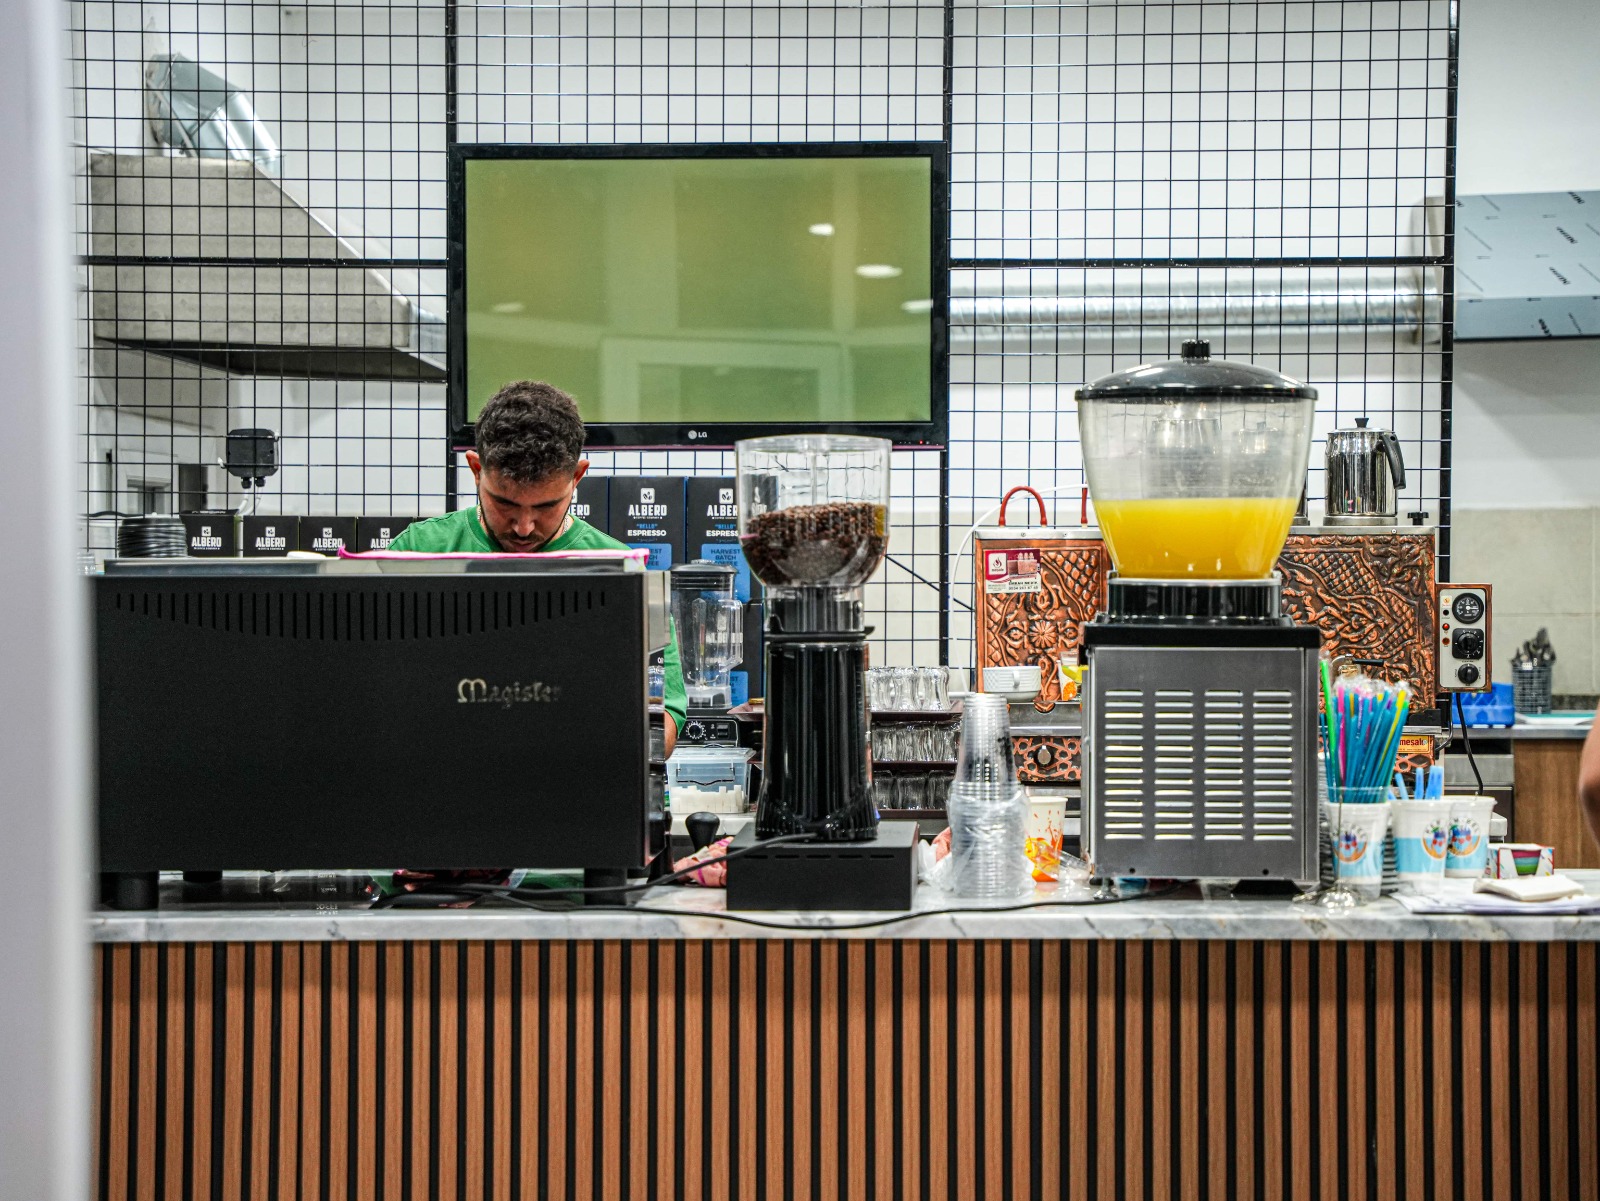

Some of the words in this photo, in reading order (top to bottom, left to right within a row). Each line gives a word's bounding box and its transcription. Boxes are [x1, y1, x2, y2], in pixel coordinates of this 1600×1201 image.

[568, 504, 590, 517] ERO
[628, 504, 668, 517] ALBERO
[706, 504, 739, 517] ALBER
[627, 529, 667, 537] ESPRESSO
[191, 536, 222, 547] ALBERO
[255, 537, 286, 548] ALBERO
[312, 537, 343, 548] ALBERO
